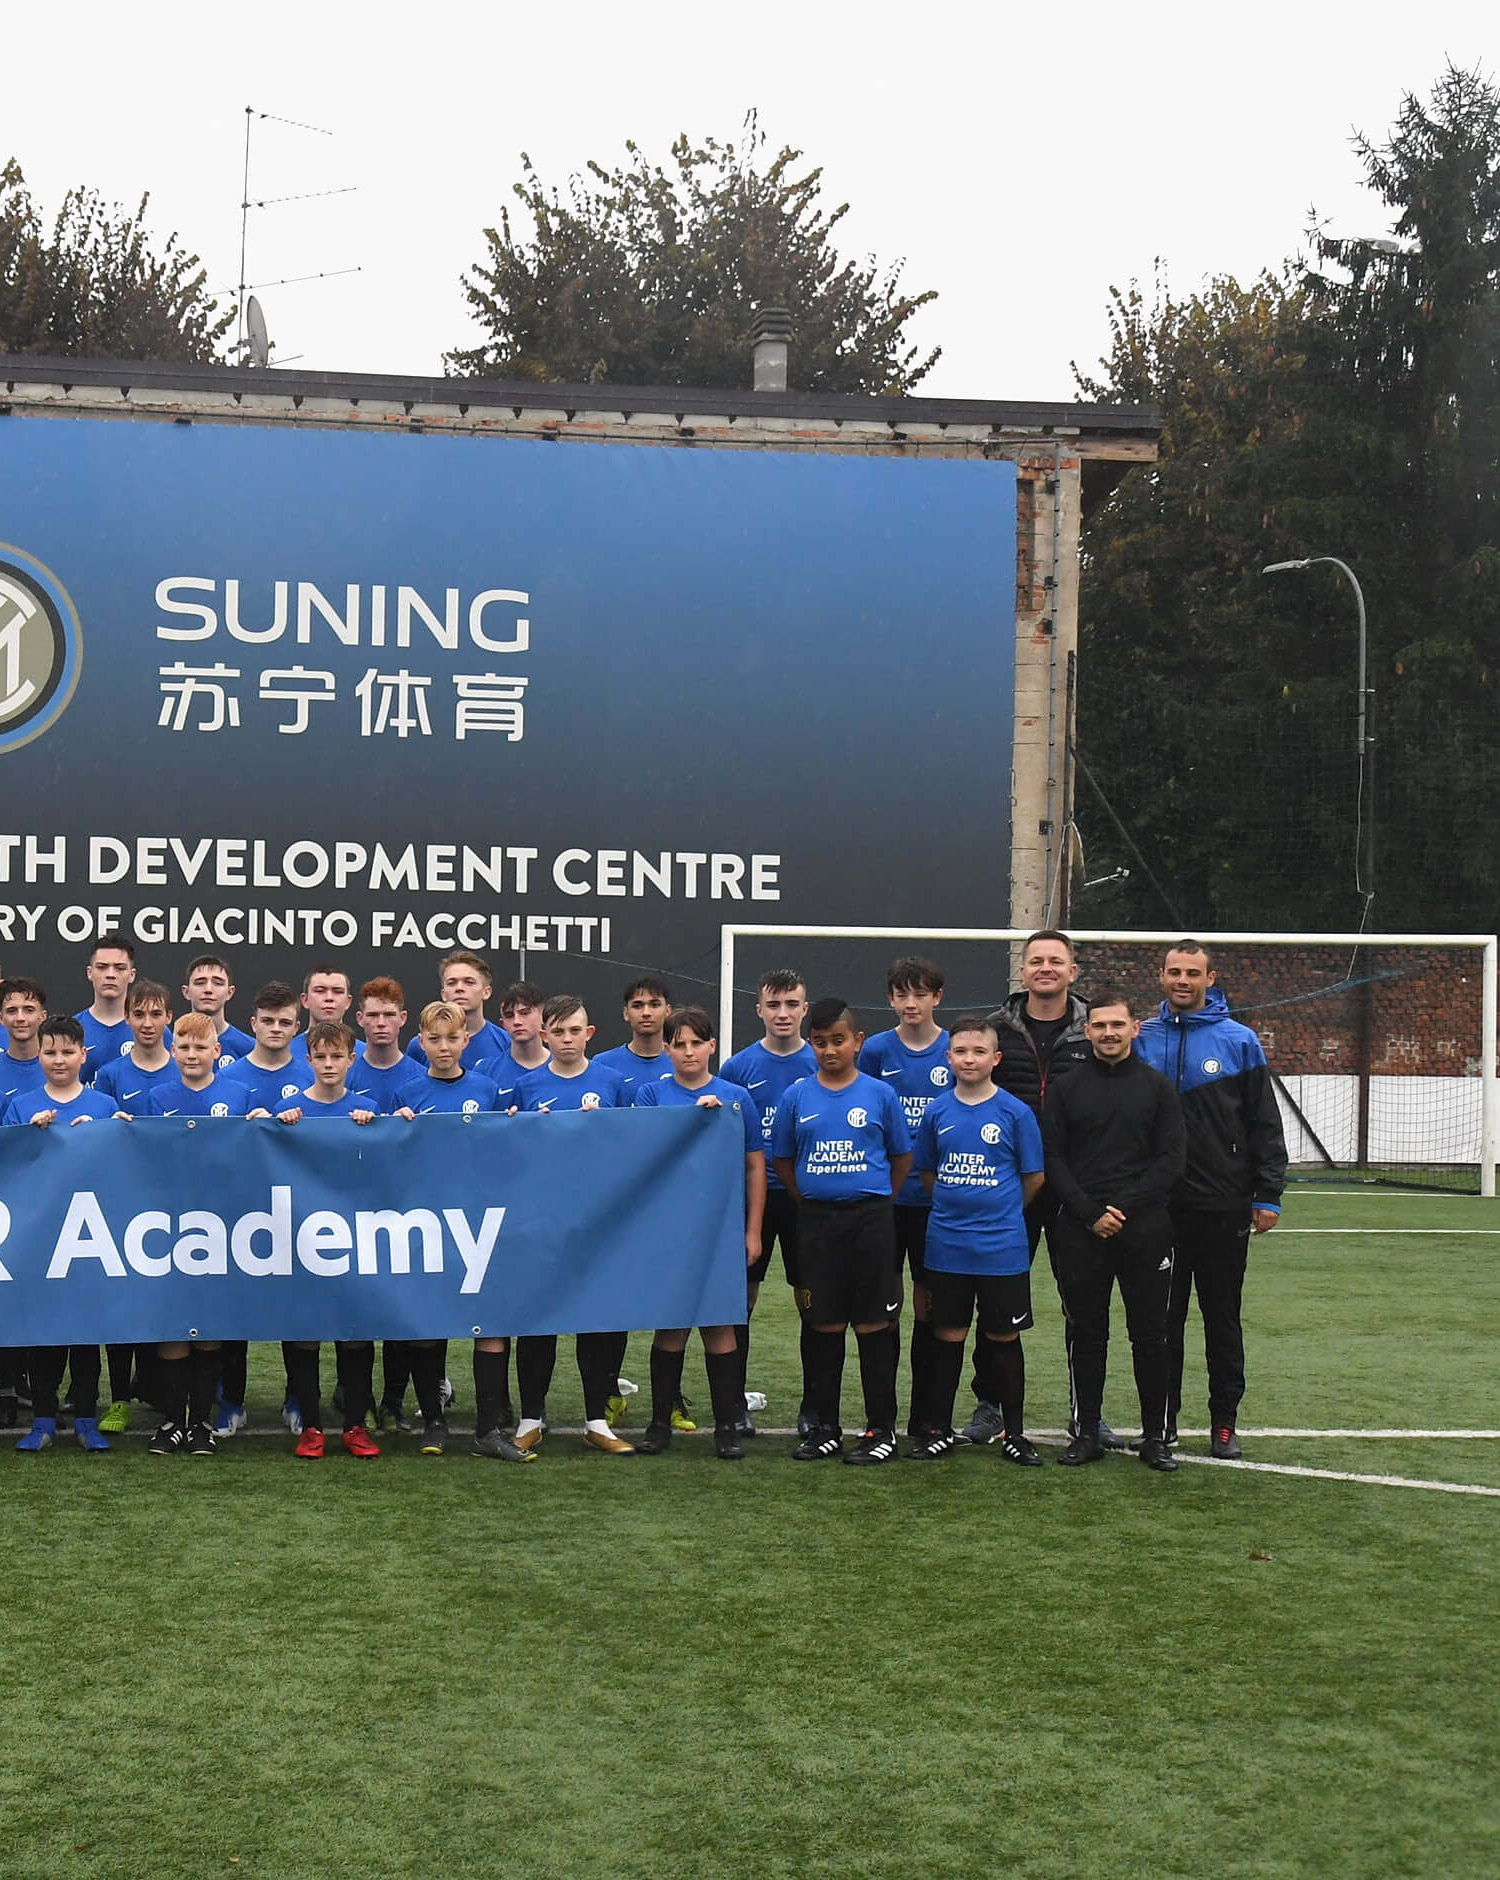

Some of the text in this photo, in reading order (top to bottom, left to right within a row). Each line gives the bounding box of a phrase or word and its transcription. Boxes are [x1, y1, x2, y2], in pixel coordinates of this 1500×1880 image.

[155, 576, 530, 653] SUNING
[157, 661, 529, 742] 苏宁体育
[89, 836, 538, 894] DEVELOPMENT
[552, 848, 781, 901] CENTRE
[57, 905, 122, 942] OF
[133, 906, 358, 947] GIACINTO
[372, 911, 610, 953] FACCHETTI
[815, 1139, 853, 1152] INTER
[808, 1150, 866, 1163] ACADEMY
[948, 1152, 985, 1166] INTER
[806, 1162, 868, 1176] Experience
[940, 1162, 997, 1177] ACADEMY
[937, 1173, 999, 1188] Experience
[46, 1185, 507, 1294] Academy
